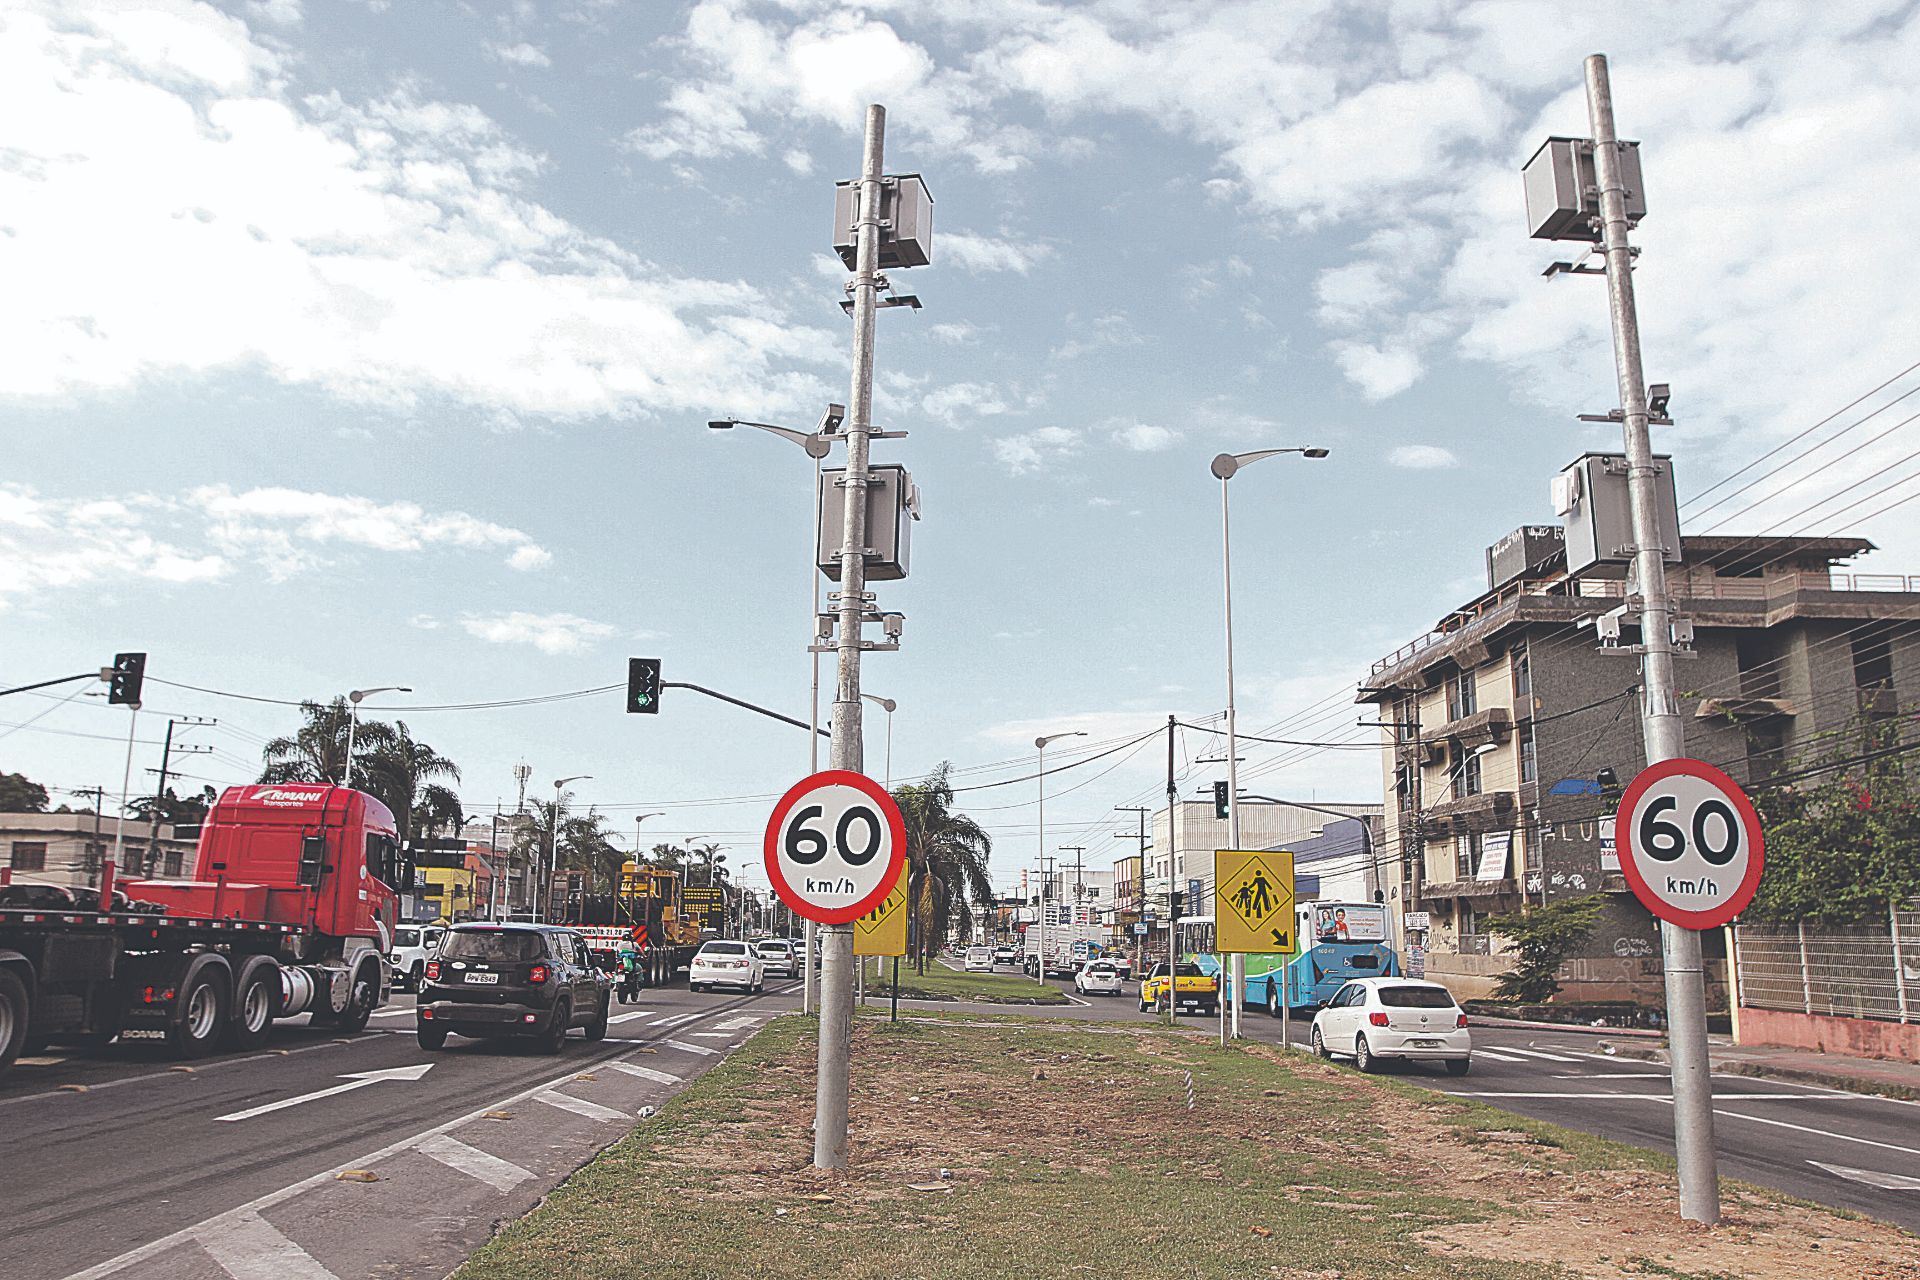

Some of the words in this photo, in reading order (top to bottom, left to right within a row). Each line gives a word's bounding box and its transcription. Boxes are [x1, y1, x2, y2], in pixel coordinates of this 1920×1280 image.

[785, 805, 882, 866] 60
[1639, 796, 1739, 866] 60
[806, 877, 855, 894] km/h
[1667, 876, 1718, 896] km/h
